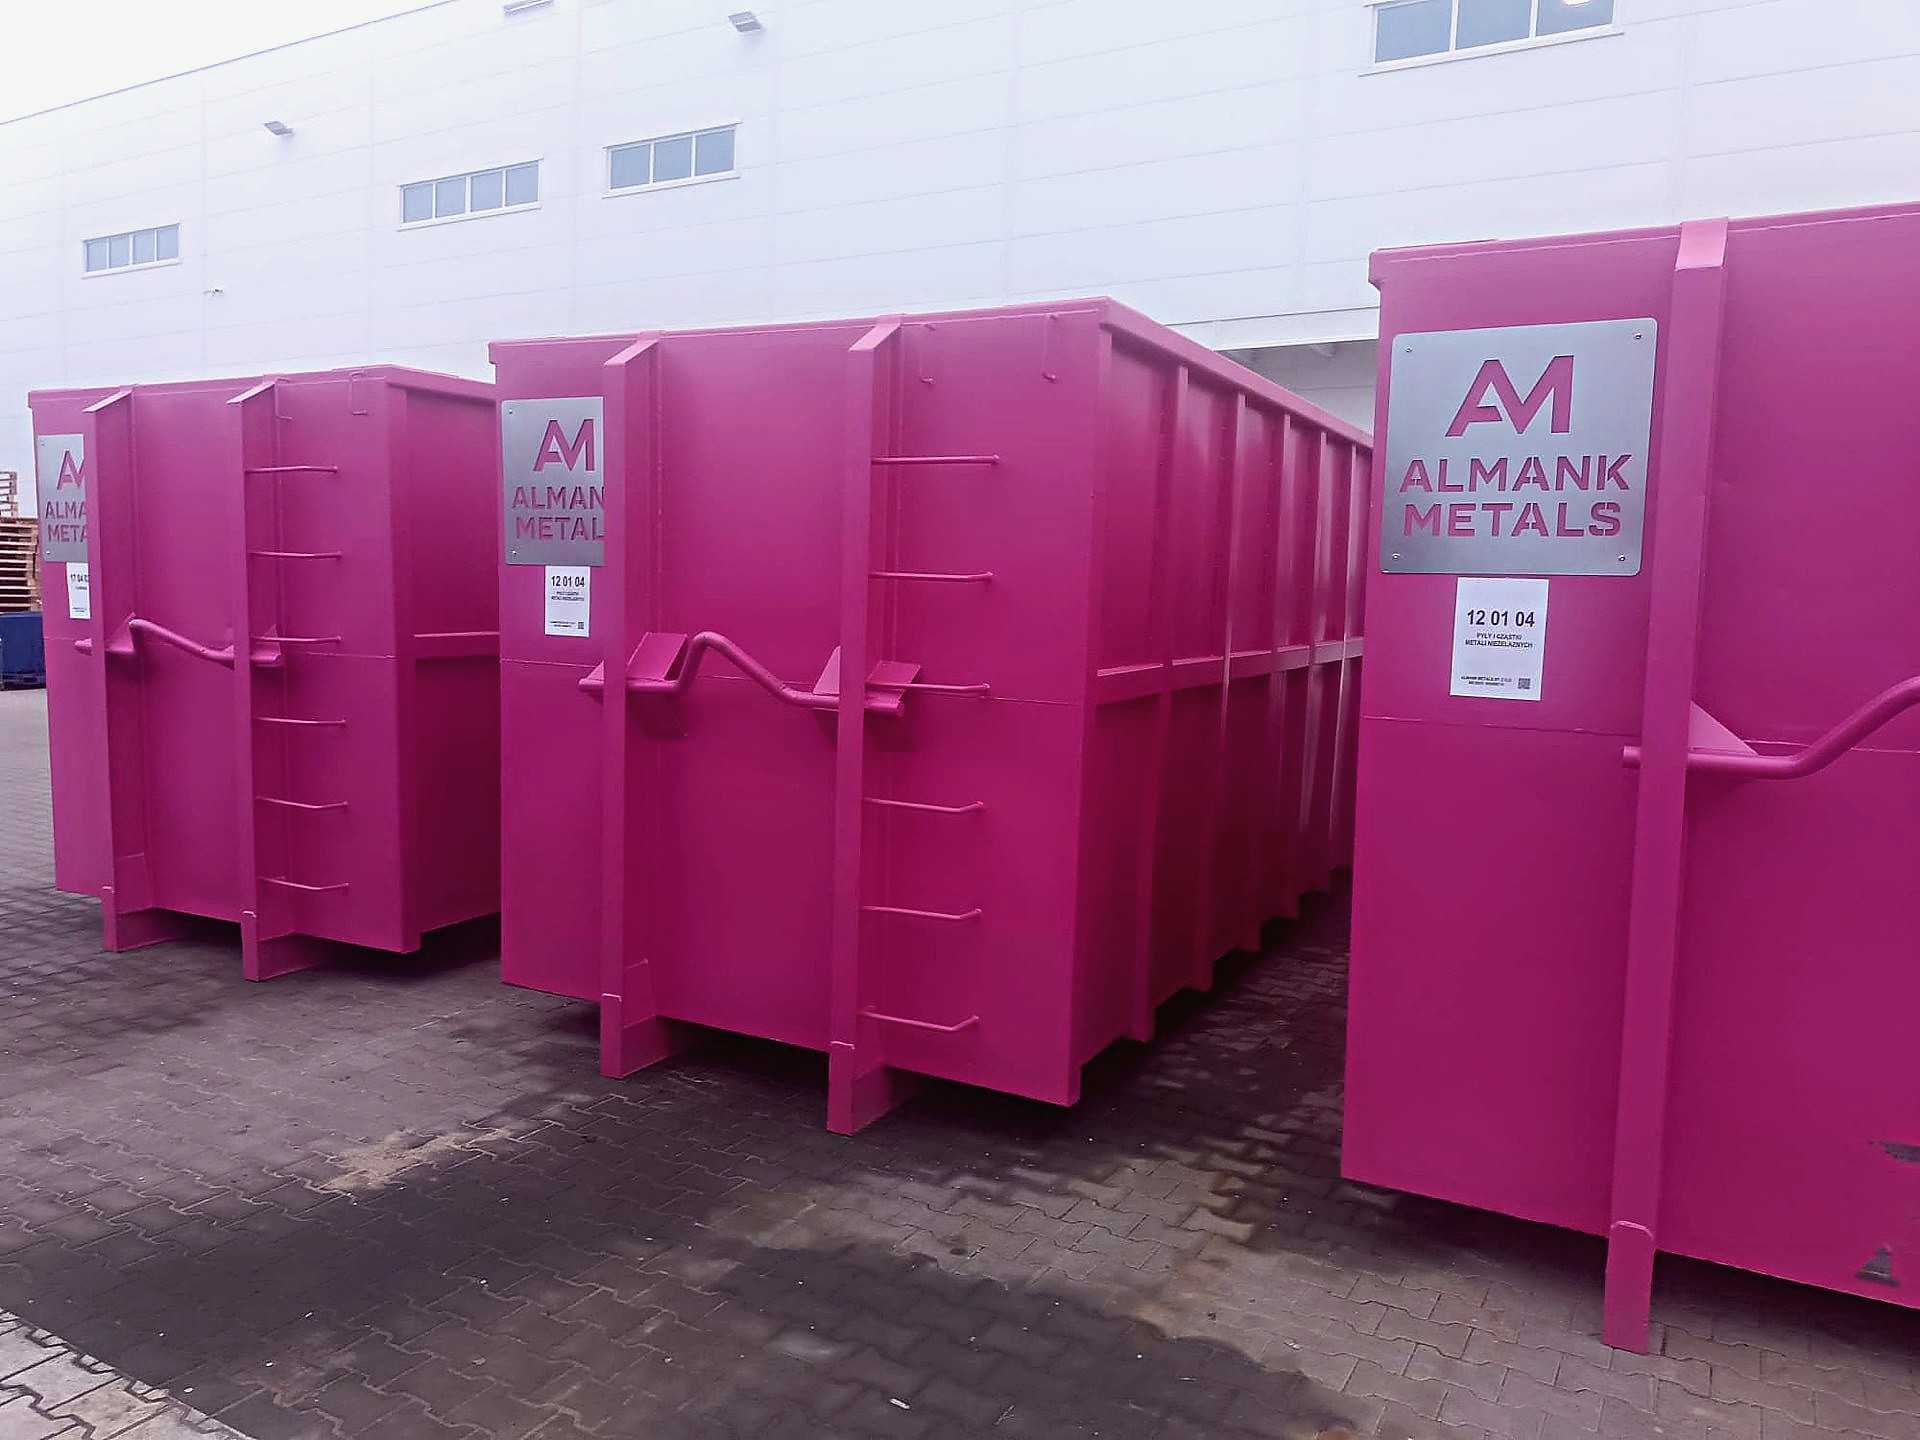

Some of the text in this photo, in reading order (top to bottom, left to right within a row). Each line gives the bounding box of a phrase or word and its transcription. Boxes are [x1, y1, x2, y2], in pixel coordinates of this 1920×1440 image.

[1445, 355, 1575, 437] AM
[533, 418, 595, 472] AM
[1399, 454, 1632, 493] ALMANK
[512, 486, 605, 510] ALMAN
[516, 516, 605, 541] METAL
[1403, 501, 1622, 537] METALS
[551, 575, 585, 587] 12 01 04
[1467, 609, 1535, 628] 12 01 04
